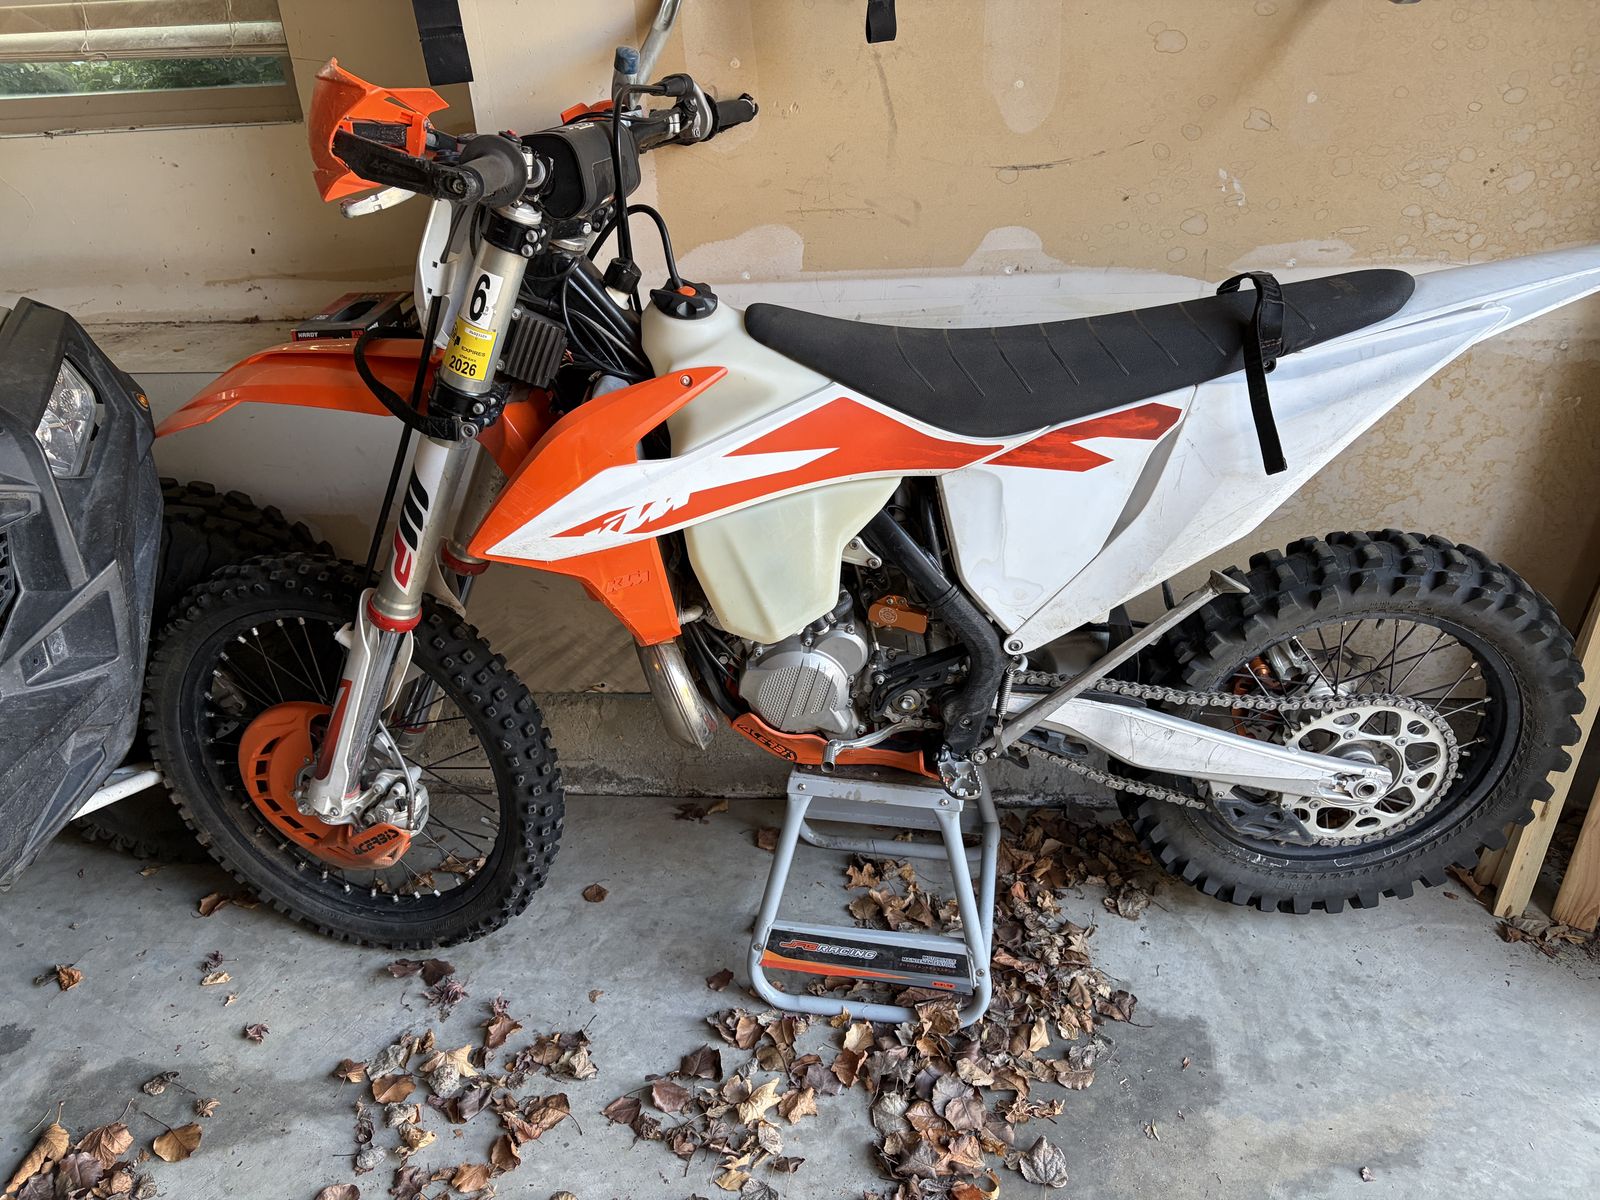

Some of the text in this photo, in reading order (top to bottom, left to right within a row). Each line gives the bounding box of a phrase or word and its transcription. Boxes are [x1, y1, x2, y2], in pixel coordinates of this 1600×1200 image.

[470, 273, 491, 322] 6
[461, 345, 486, 357] EXPIRES
[448, 355, 477, 376] 2026
[816, 943, 878, 960] RACING
